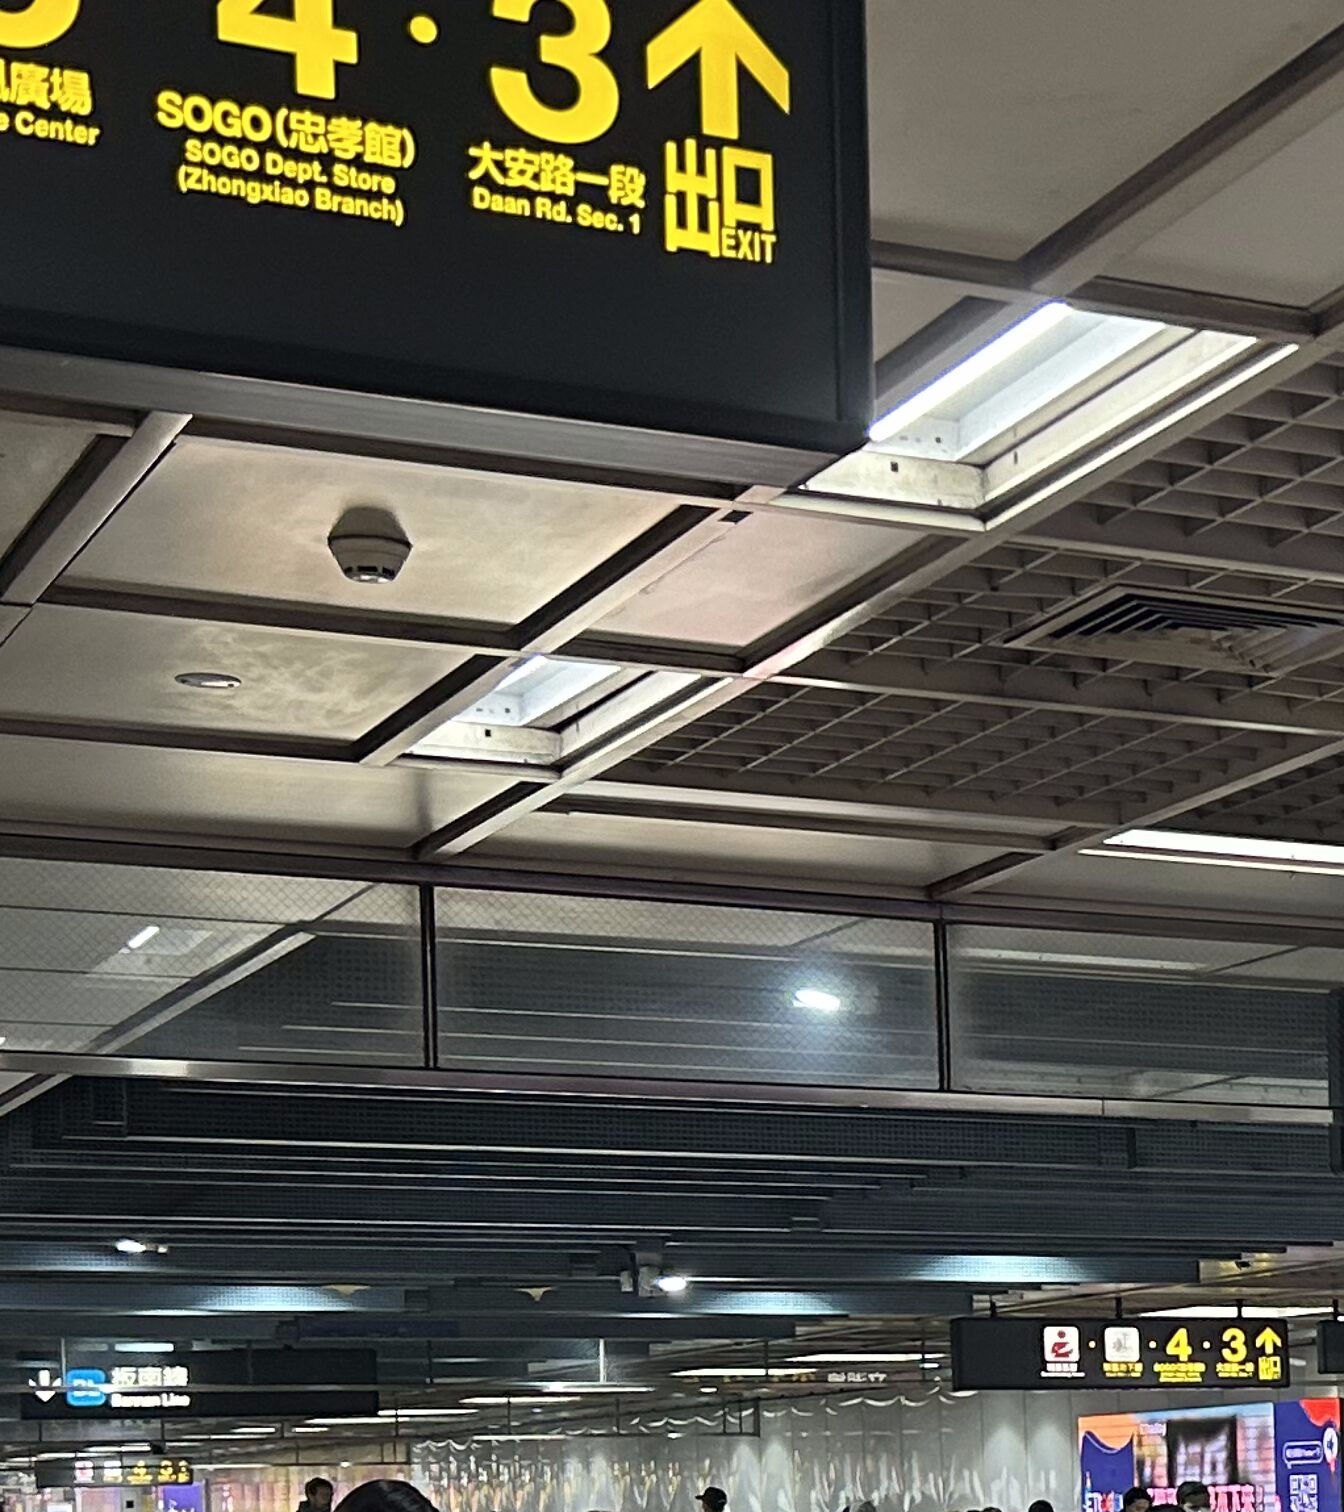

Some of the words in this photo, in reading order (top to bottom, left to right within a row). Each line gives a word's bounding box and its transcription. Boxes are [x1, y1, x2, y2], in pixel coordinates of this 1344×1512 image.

[490, 0, 620, 145] 3
[14, 111, 99, 146] Center
[155, 89, 417, 169] SOGO(忠孝館)
[177, 164, 310, 206] (Zhongxiao
[313, 187, 406, 228] Branch)
[184, 138, 261, 173] SOGO
[264, 152, 328, 185] Dept.
[332, 163, 396, 195] Store
[467, 140, 647, 209] 大安路一段
[471, 185, 531, 217] Daan
[534, 196, 573, 224] Rd.
[576, 203, 625, 233] Sec.
[628, 212, 641, 235] 1
[664, 137, 774, 259] 出口
[720, 227, 778, 264] EXIT
[1166, 1327, 1193, 1363] 4
[1221, 1327, 1248, 1363] 3
